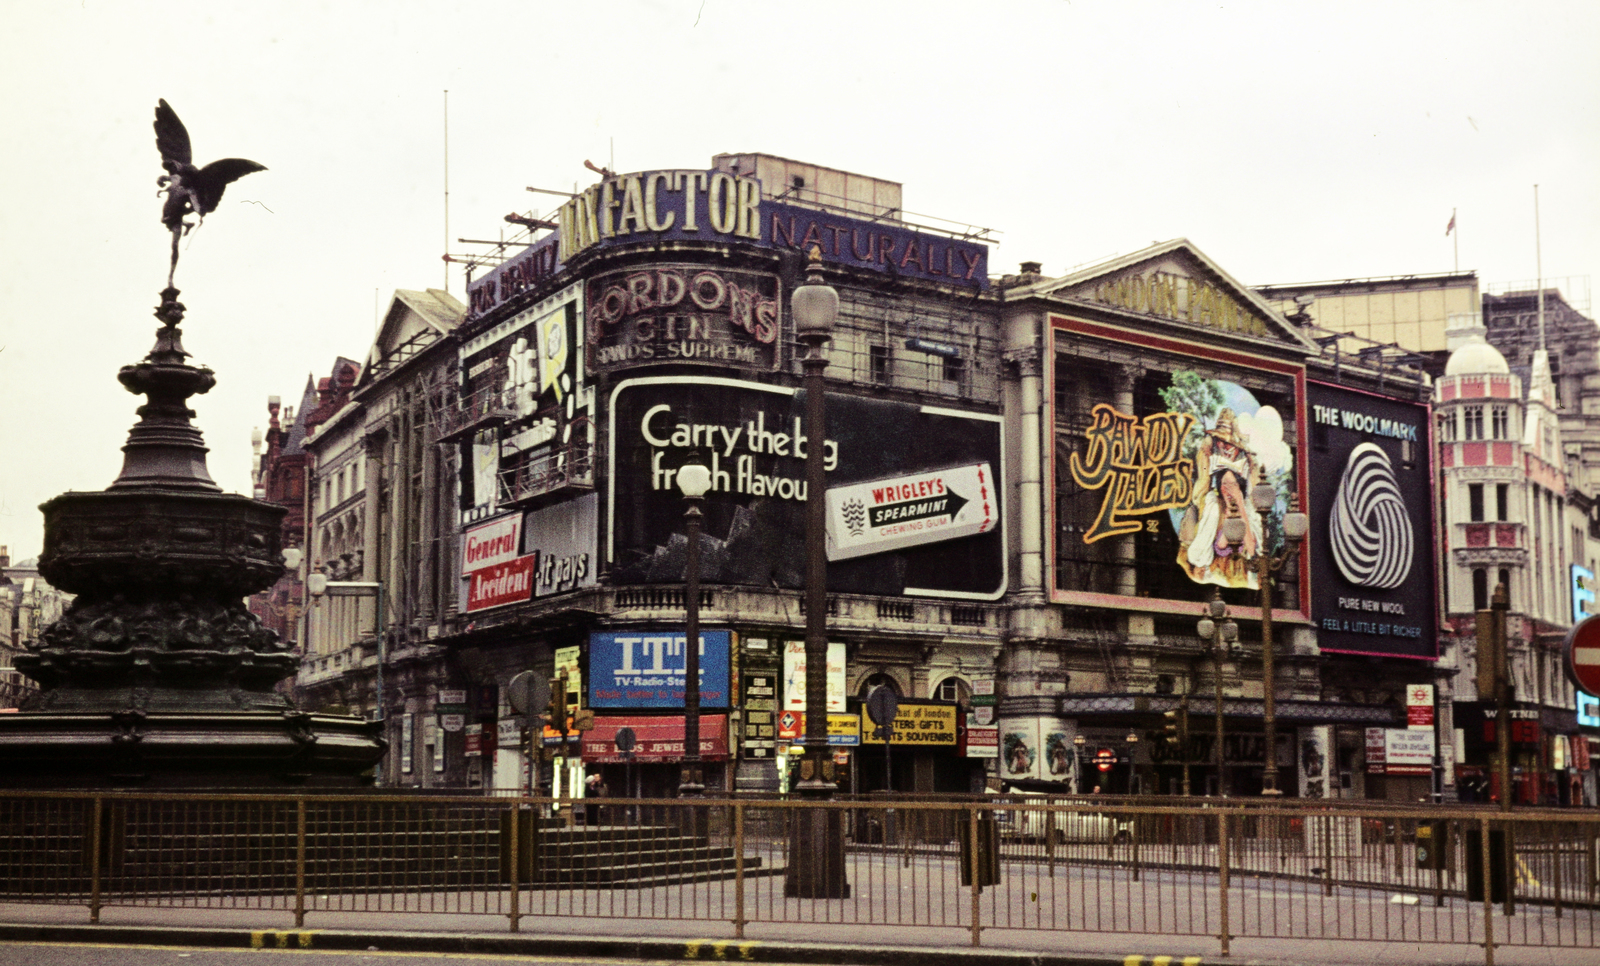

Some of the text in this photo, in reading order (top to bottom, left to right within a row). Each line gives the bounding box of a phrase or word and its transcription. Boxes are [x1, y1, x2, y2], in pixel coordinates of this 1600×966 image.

[600, 170, 762, 242] FACTOR
[771, 212, 981, 280] NATURALLY
[636, 312, 713, 341] GIN
[667, 340, 763, 363] SUPREME
[1313, 404, 1418, 442] THE WOOLMARK
[641, 404, 839, 471] Carry the bg
[652, 450, 808, 501] frh flavou
[872, 478, 944, 504] WRIGLEY'S
[875, 499, 948, 523] SPEARMINT
[880, 517, 947, 537] CHEWING GUM
[467, 524, 516, 564] General
[471, 566, 530, 602] Accident
[554, 553, 586, 592] pays
[1338, 597, 1405, 615] PURE NEW WOOL
[1323, 618, 1421, 637] FEEL A LITTLE BIT RICHER
[906, 732, 954, 742] SOUVENIRS
[919, 721, 945, 730] GIFTS
[585, 743, 607, 753] THE
[649, 742, 714, 753] JEWELRS
